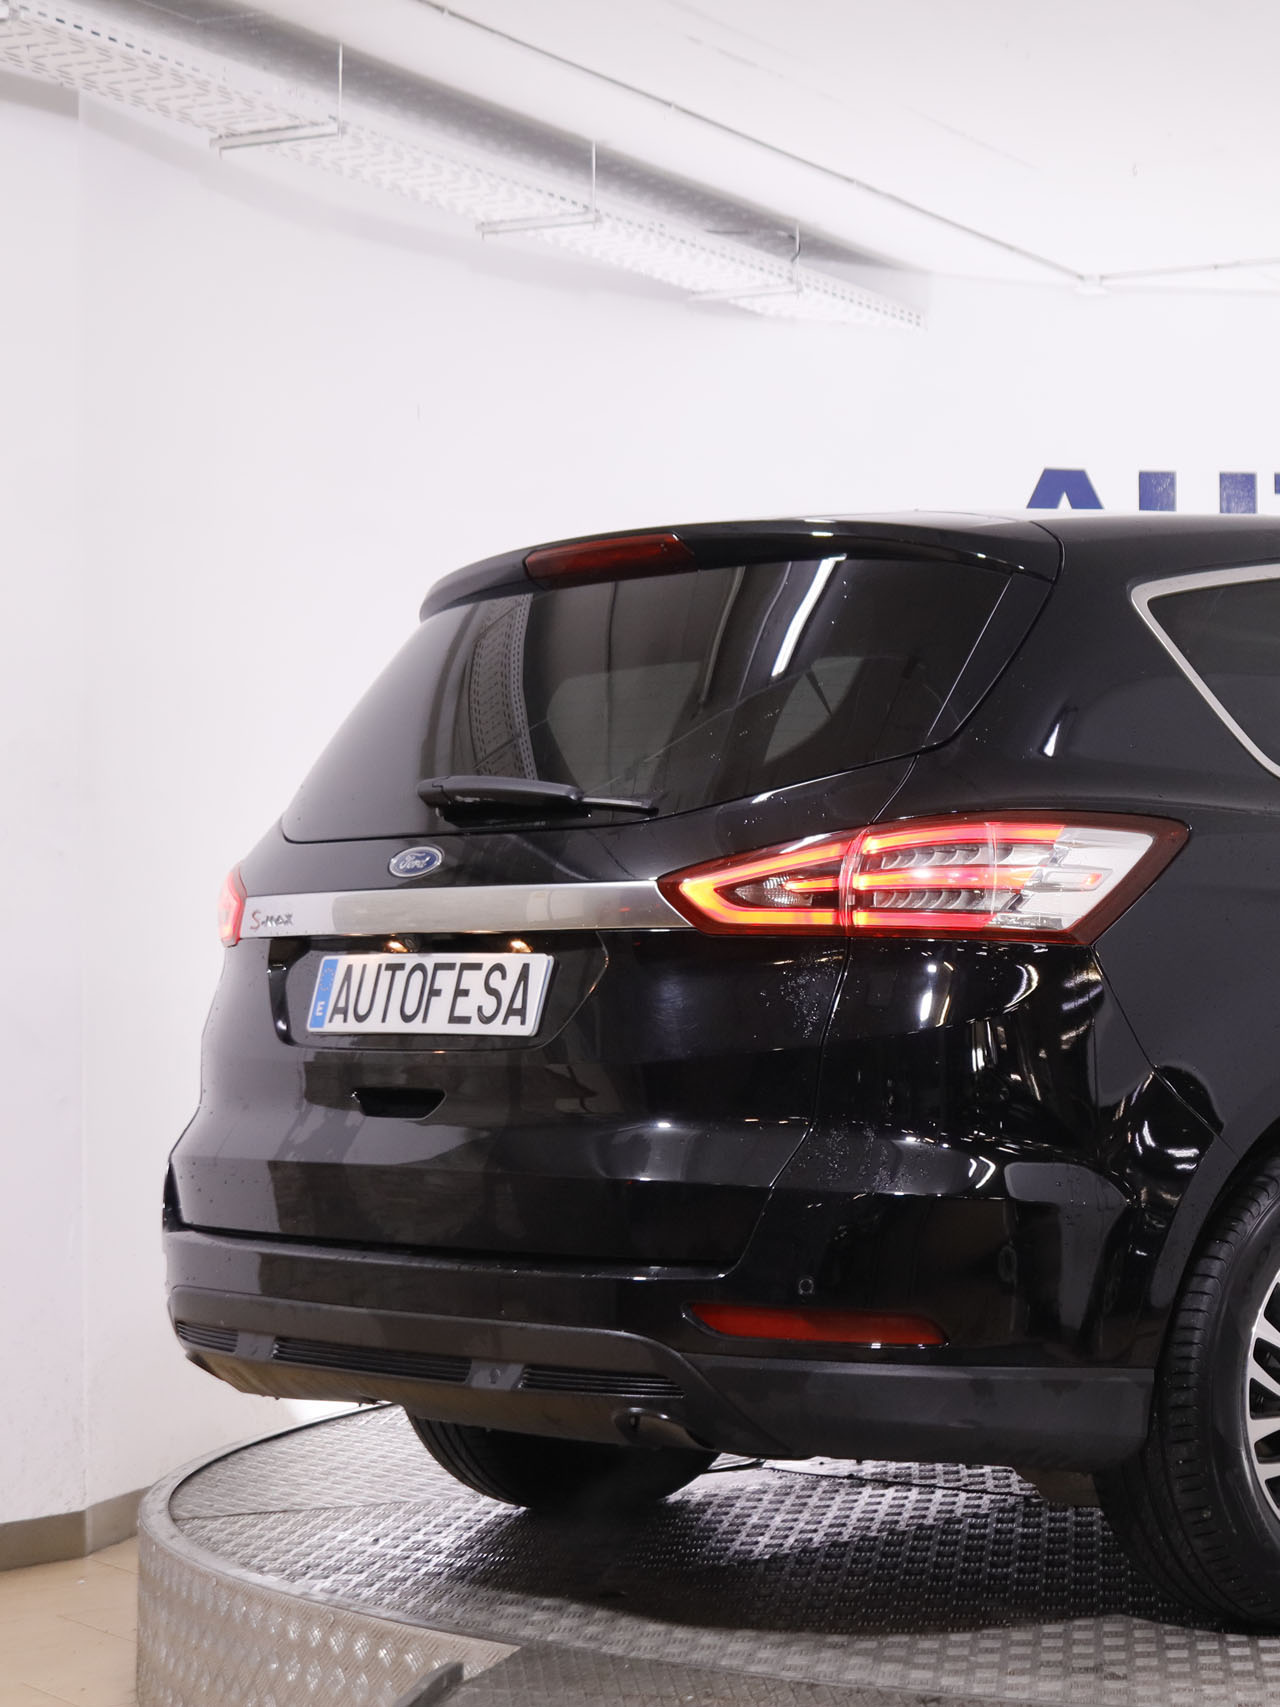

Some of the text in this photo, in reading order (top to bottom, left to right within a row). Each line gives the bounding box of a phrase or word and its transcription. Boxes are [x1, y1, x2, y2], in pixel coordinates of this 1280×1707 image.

[398, 851, 433, 870] Ford
[328, 962, 531, 1026] AUTOFESA
[315, 1001, 325, 1017] E
